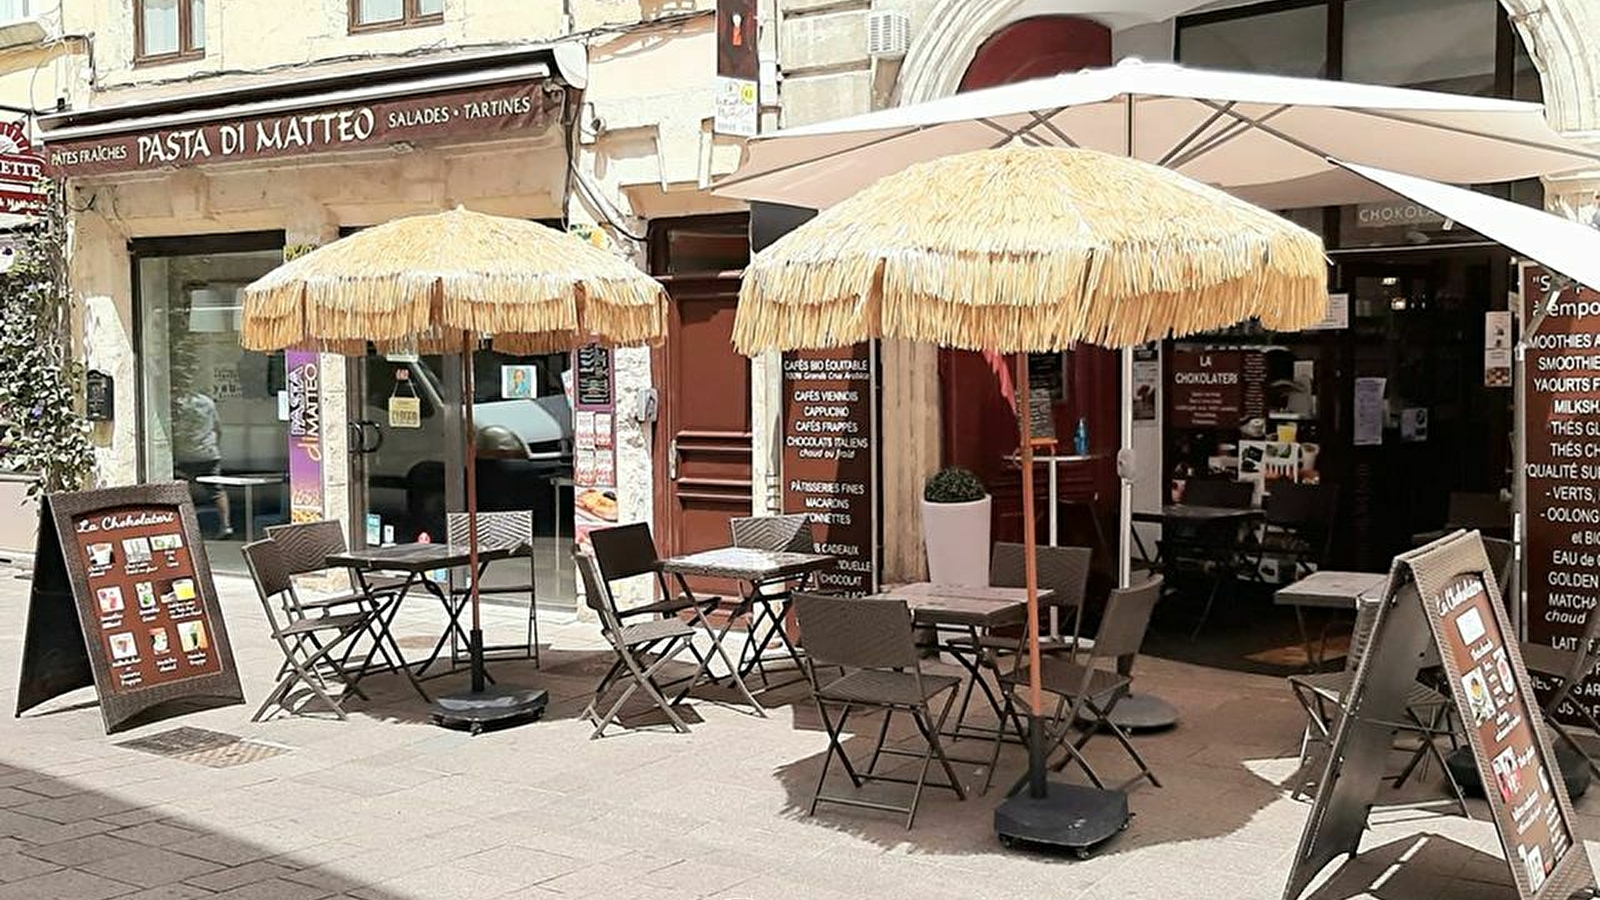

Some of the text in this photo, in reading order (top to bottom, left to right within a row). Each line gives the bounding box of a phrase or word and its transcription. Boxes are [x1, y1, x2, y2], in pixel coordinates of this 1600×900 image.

[51, 96, 532, 166] PÂTES FRAÎCHES PASTA DI MATTEO SALADES TARTINES
[1199, 356, 1212, 367] LA
[1534, 377, 1591, 392] YAOURTS
[290, 365, 305, 435] PASTA
[1554, 400, 1600, 414] MILKSH
[1551, 420, 1583, 436] THÉS
[1550, 441, 1582, 458] THÉS
[841, 483, 866, 495] FINES
[1553, 486, 1596, 503] VERTS,
[77, 512, 175, 533] La Chokolateri
[1547, 506, 1600, 523] OOLONG
[1553, 549, 1595, 567] EAU de
[1547, 570, 1599, 589] GOLDEN
[1548, 592, 1598, 610] MATCHA
[1544, 609, 1588, 625] chaud
[1551, 635, 1578, 651] LAIT
